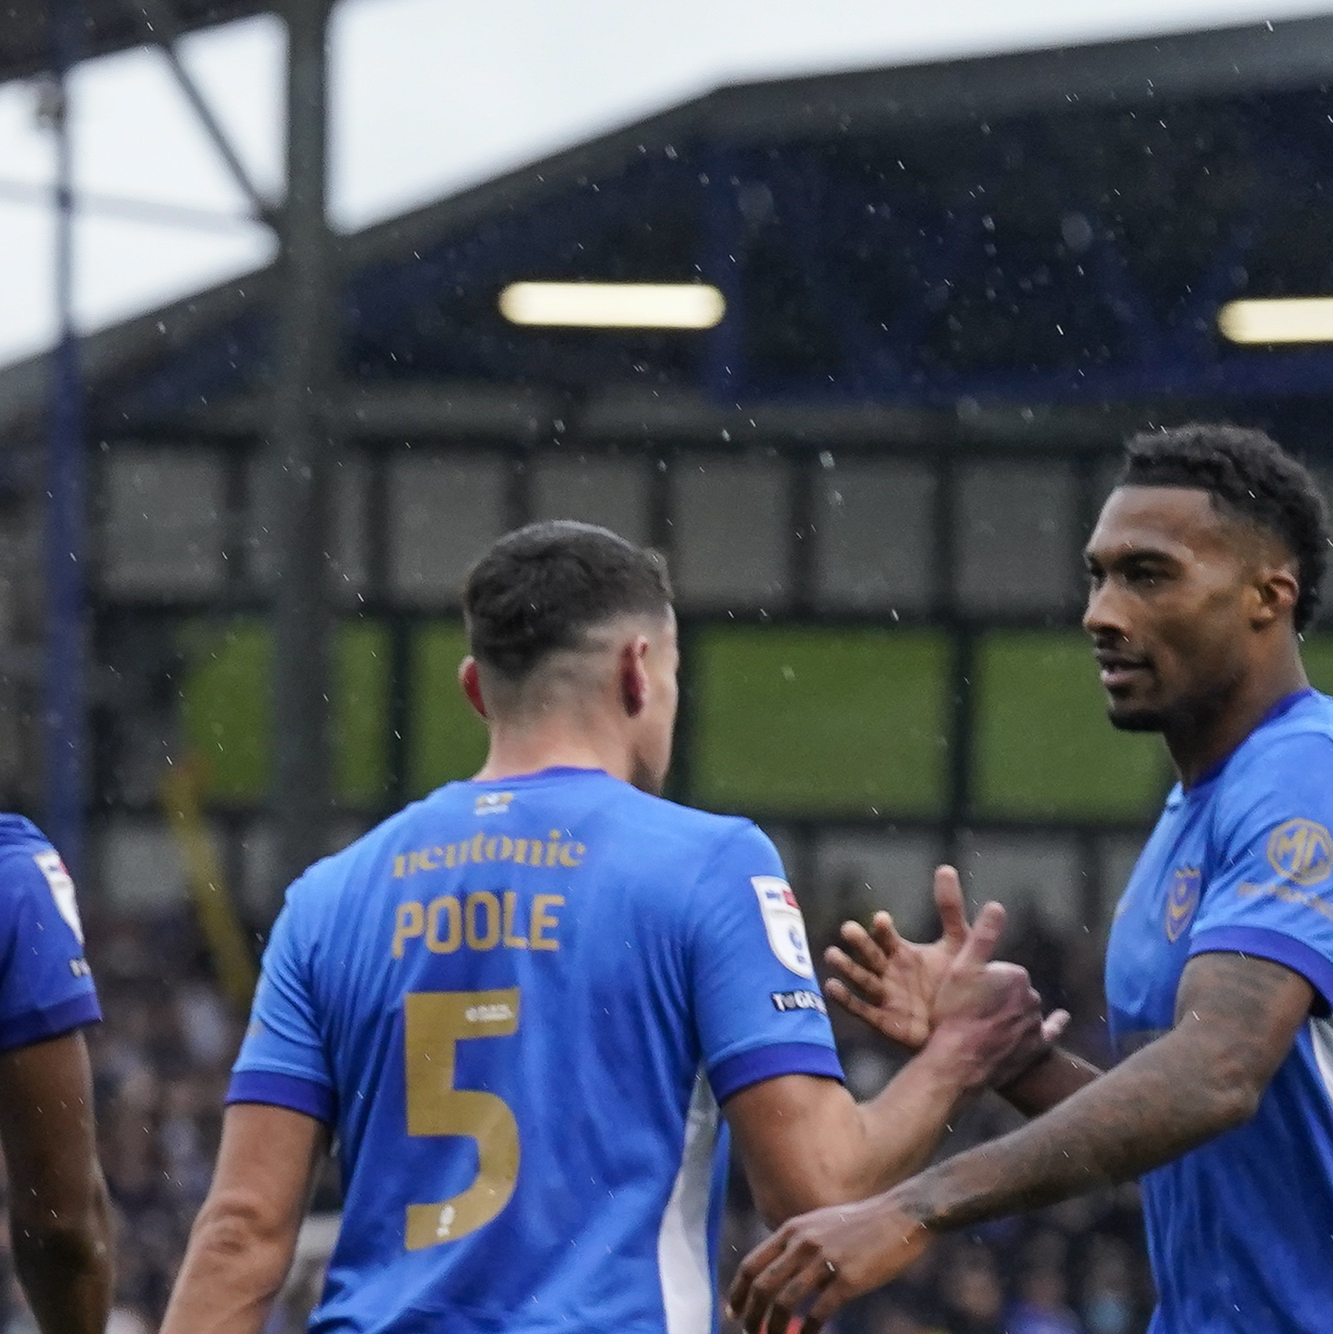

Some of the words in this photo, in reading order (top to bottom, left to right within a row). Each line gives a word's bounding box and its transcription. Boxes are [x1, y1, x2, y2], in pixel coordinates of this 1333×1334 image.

[393, 829, 586, 878] neutonic
[392, 890, 566, 959] POOLE
[404, 986, 521, 1251] 5
